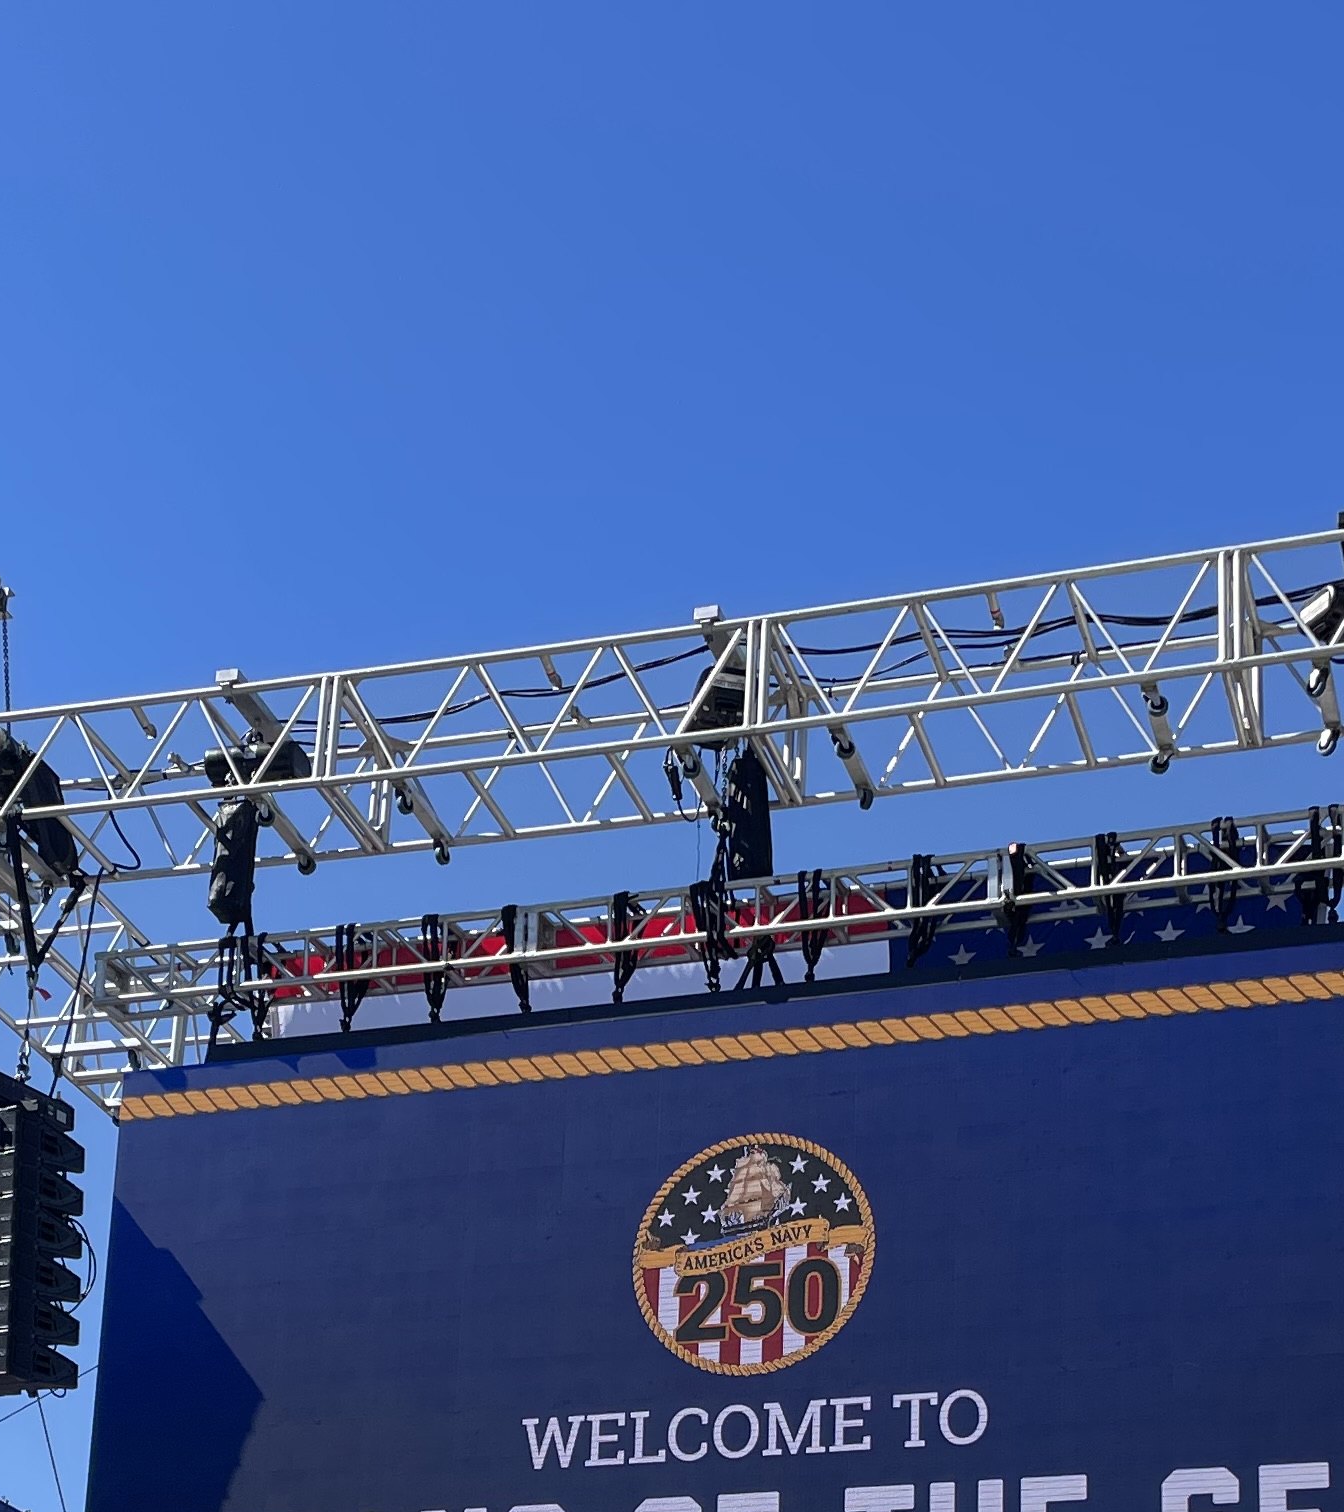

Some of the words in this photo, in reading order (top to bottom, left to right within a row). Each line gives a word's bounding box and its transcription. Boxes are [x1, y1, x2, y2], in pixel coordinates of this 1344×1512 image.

[682, 1237, 765, 1271] AMERICA'S
[770, 1223, 813, 1247] NAVY
[672, 1256, 843, 1344] 250
[522, 1395, 871, 1470] WELCOME
[892, 1389, 989, 1448] TO
